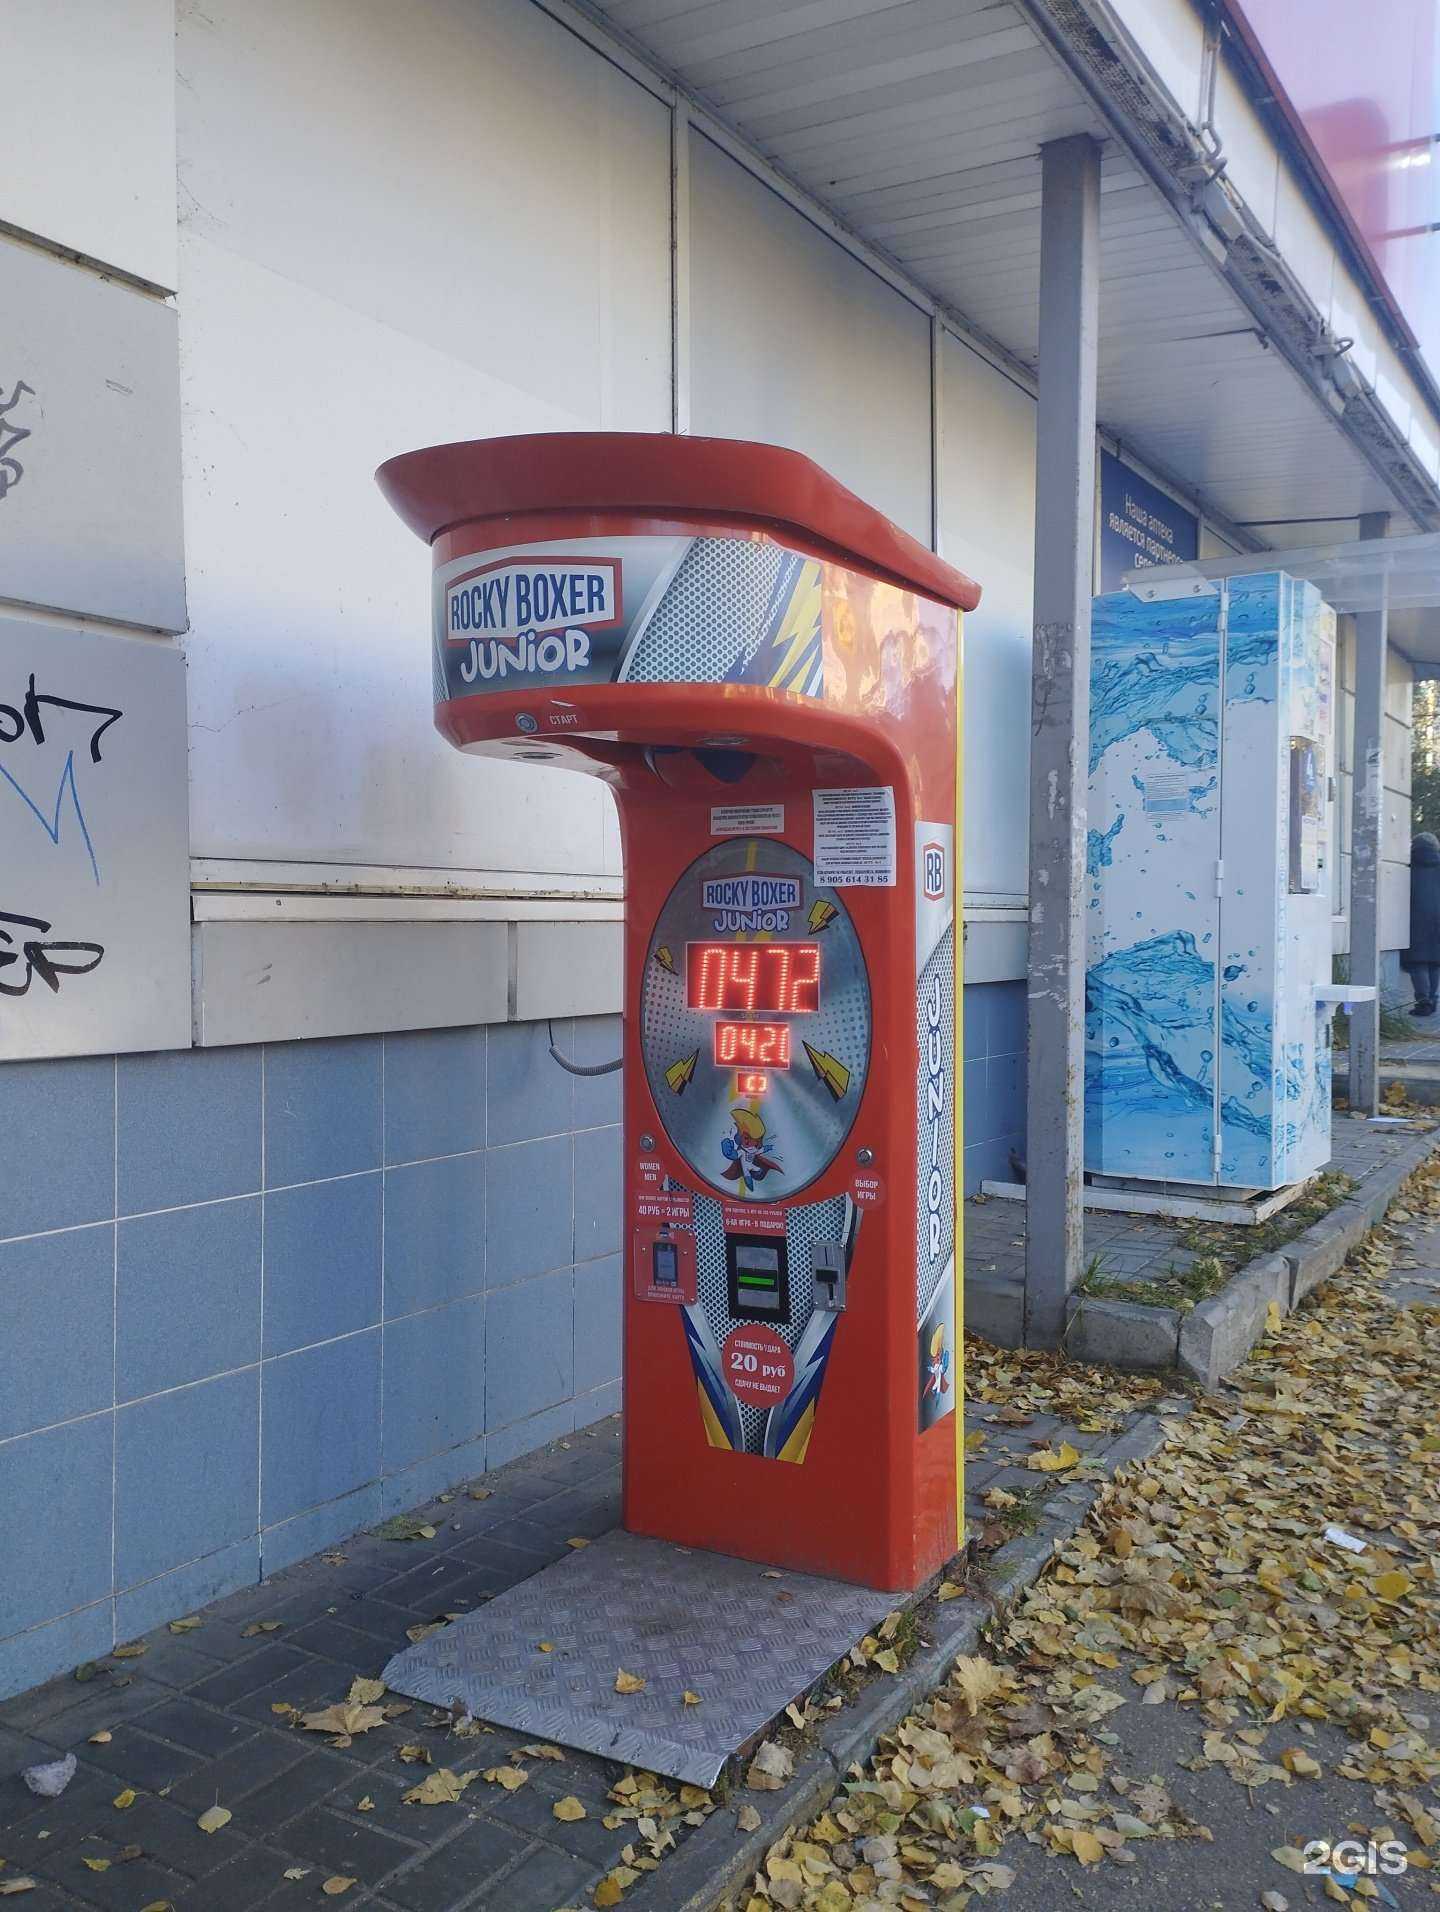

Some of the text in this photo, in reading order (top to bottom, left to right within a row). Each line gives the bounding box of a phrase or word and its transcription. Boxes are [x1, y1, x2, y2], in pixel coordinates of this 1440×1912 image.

[1125, 493, 1173, 544] Наша аптека
[1109, 512, 1145, 549] является
[451, 573, 605, 630] ROCKY BOXER
[550, 714, 578, 725] СТАРТ
[926, 851, 942, 893] RB
[827, 876, 843, 884] 905
[706, 880, 796, 907] ROCKY BOXER
[699, 948, 819, 1012] 0472
[640, 1162, 660, 1171] WOMEN
[644, 1173, 657, 1181] MEN
[855, 1180, 879, 1189] ВЫБОР
[857, 1191, 876, 1200] ИГРЫ
[638, 1205, 647, 1215] 40
[647, 1206, 660, 1216] РУБ
[666, 1207, 671, 1216] 2
[671, 1207, 690, 1217] ИГРЫ
[734, 1339, 781, 1353] СТОИМОСТЬ УДАРА
[731, 1352, 786, 1378] 20 руб
[734, 1378, 781, 1393] СДАЧУ НЕ ВЫДАЕТ
